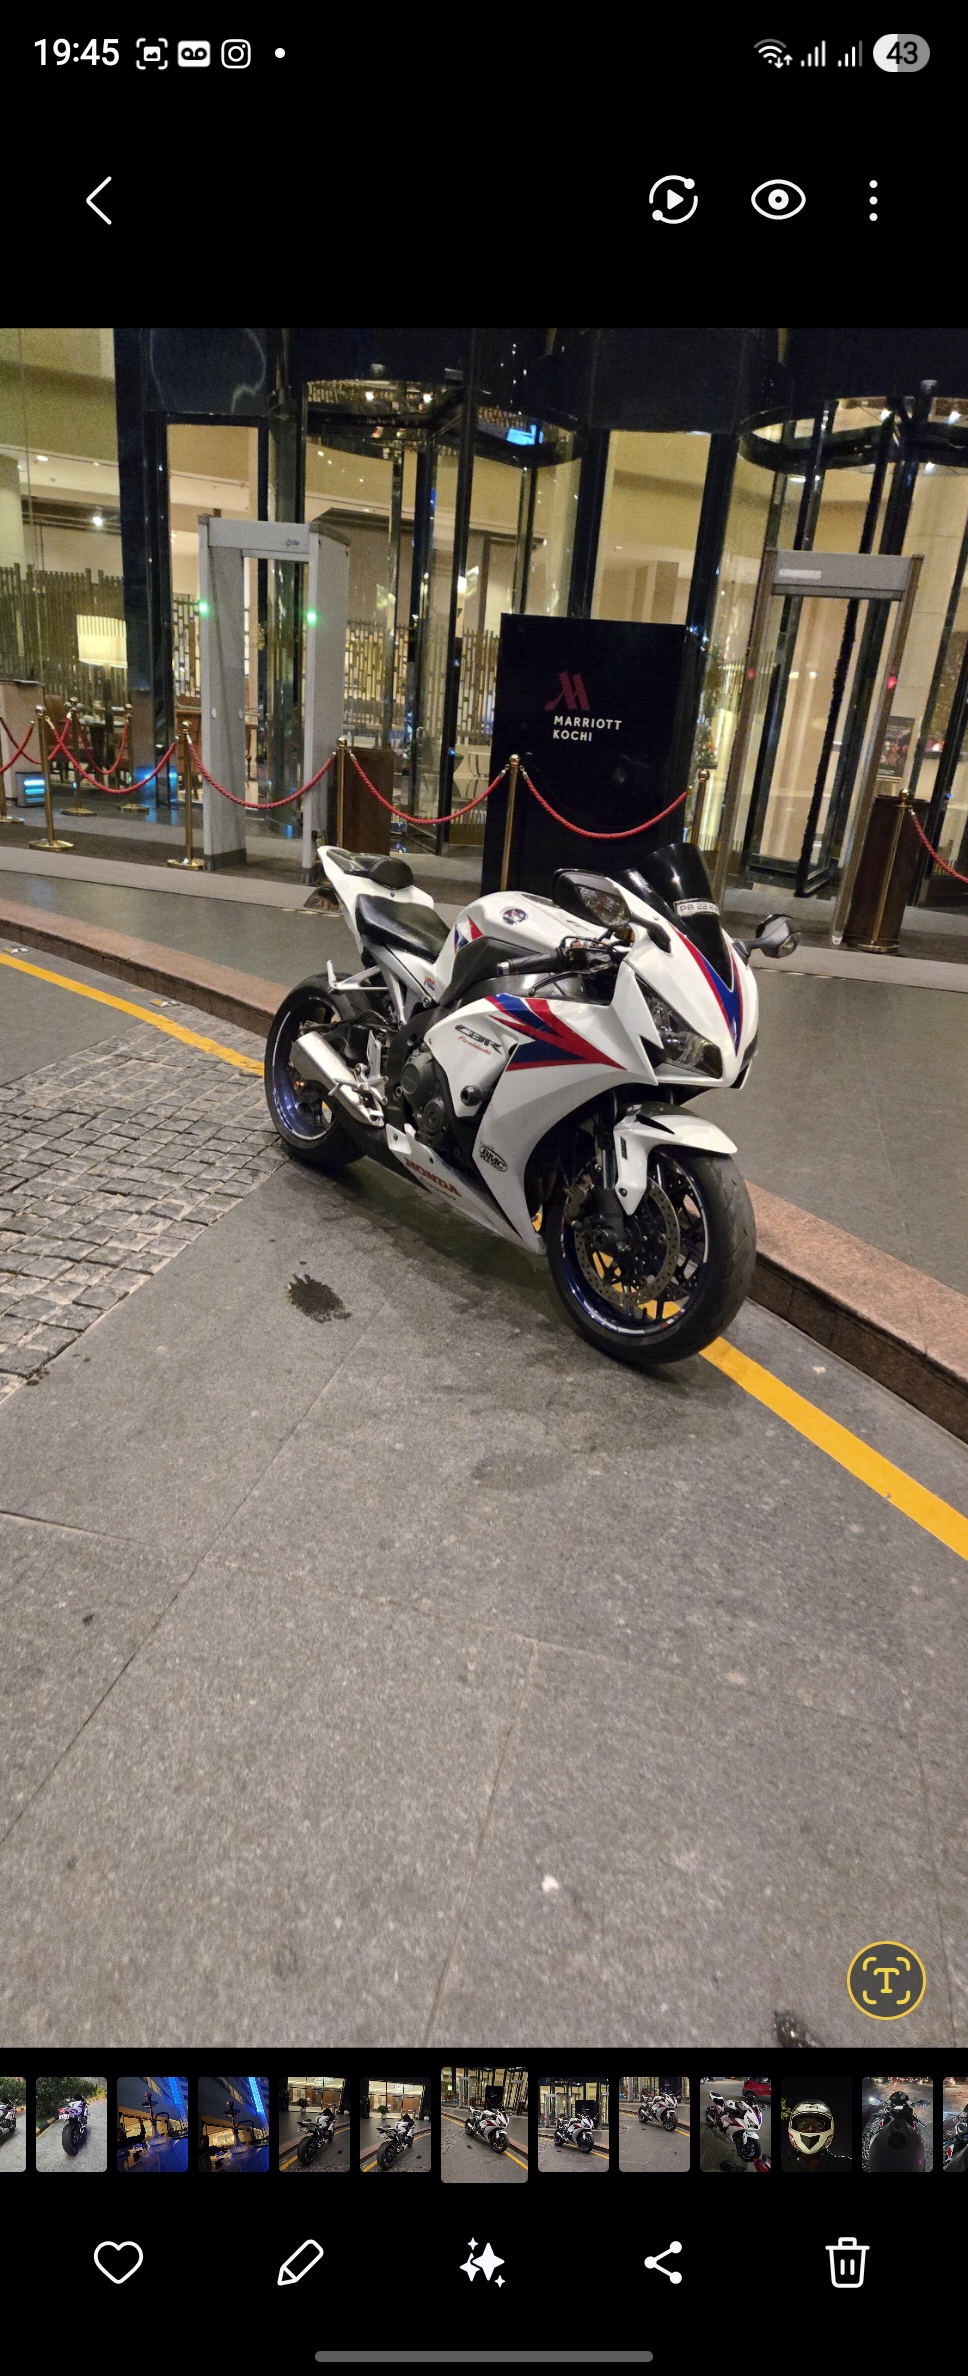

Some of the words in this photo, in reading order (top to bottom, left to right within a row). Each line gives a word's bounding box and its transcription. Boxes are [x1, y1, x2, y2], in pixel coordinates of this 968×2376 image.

[553, 715, 622, 730] MARRIOTT
[552, 729, 592, 742] KOCHI
[454, 1024, 503, 1055] CBR
[481, 1147, 505, 1170] BMC
[403, 1156, 462, 1197] HONDA
